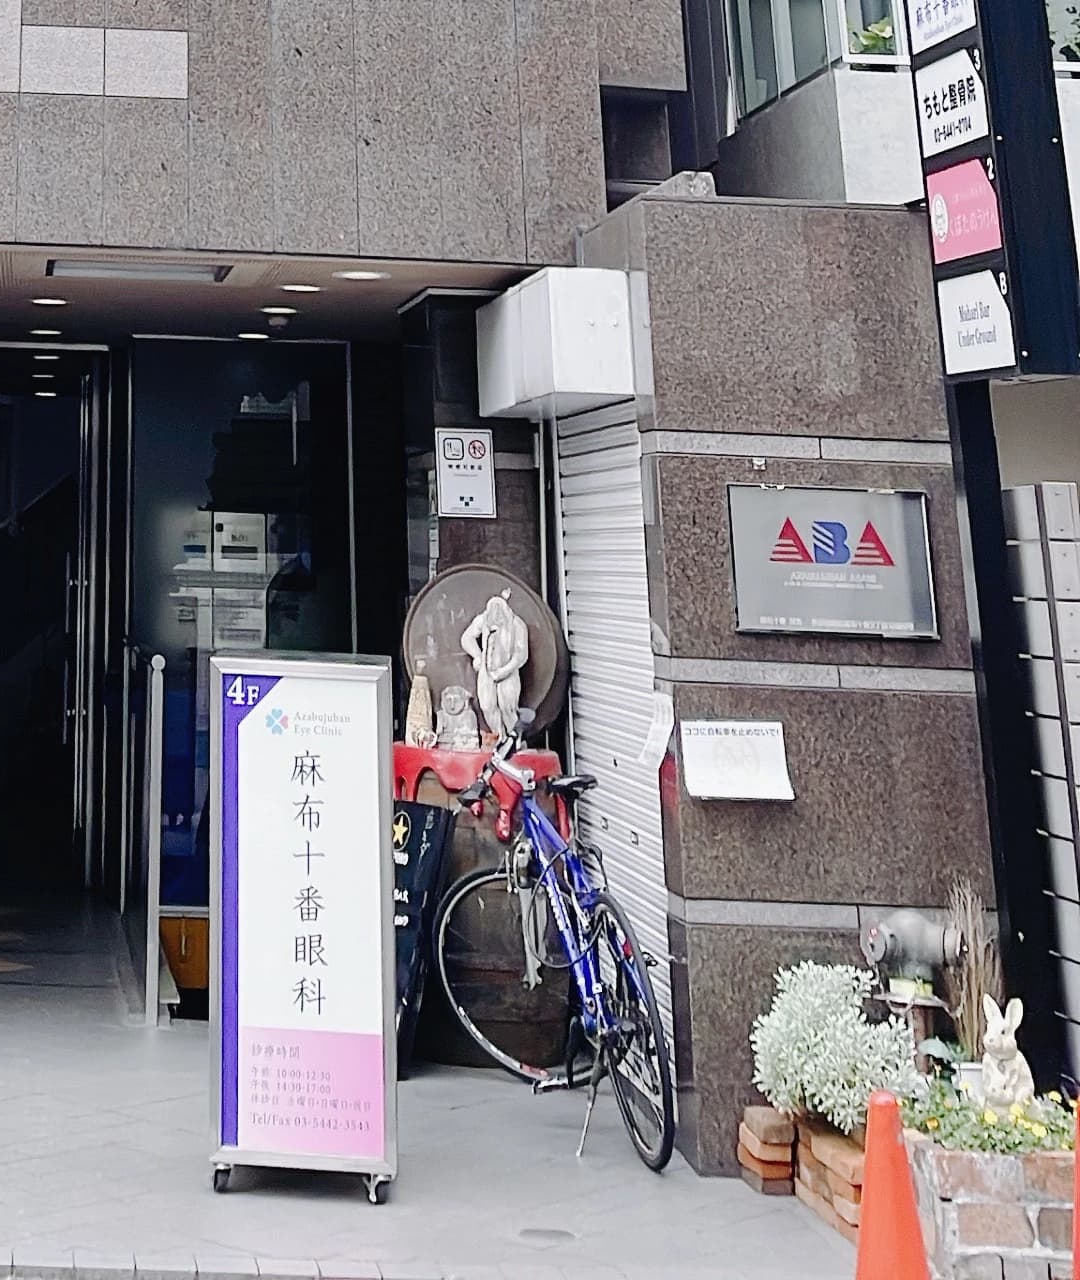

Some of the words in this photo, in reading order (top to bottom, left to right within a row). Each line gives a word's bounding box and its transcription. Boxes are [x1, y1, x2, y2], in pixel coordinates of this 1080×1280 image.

[973, 48, 981, 71] 3
[923, 74, 977, 120] ちもと整骨院
[986, 157, 995, 180] 2
[769, 516, 896, 567] ABA
[226, 675, 260, 706] 4F
[290, 750, 328, 1016] 麻布十番眼科
